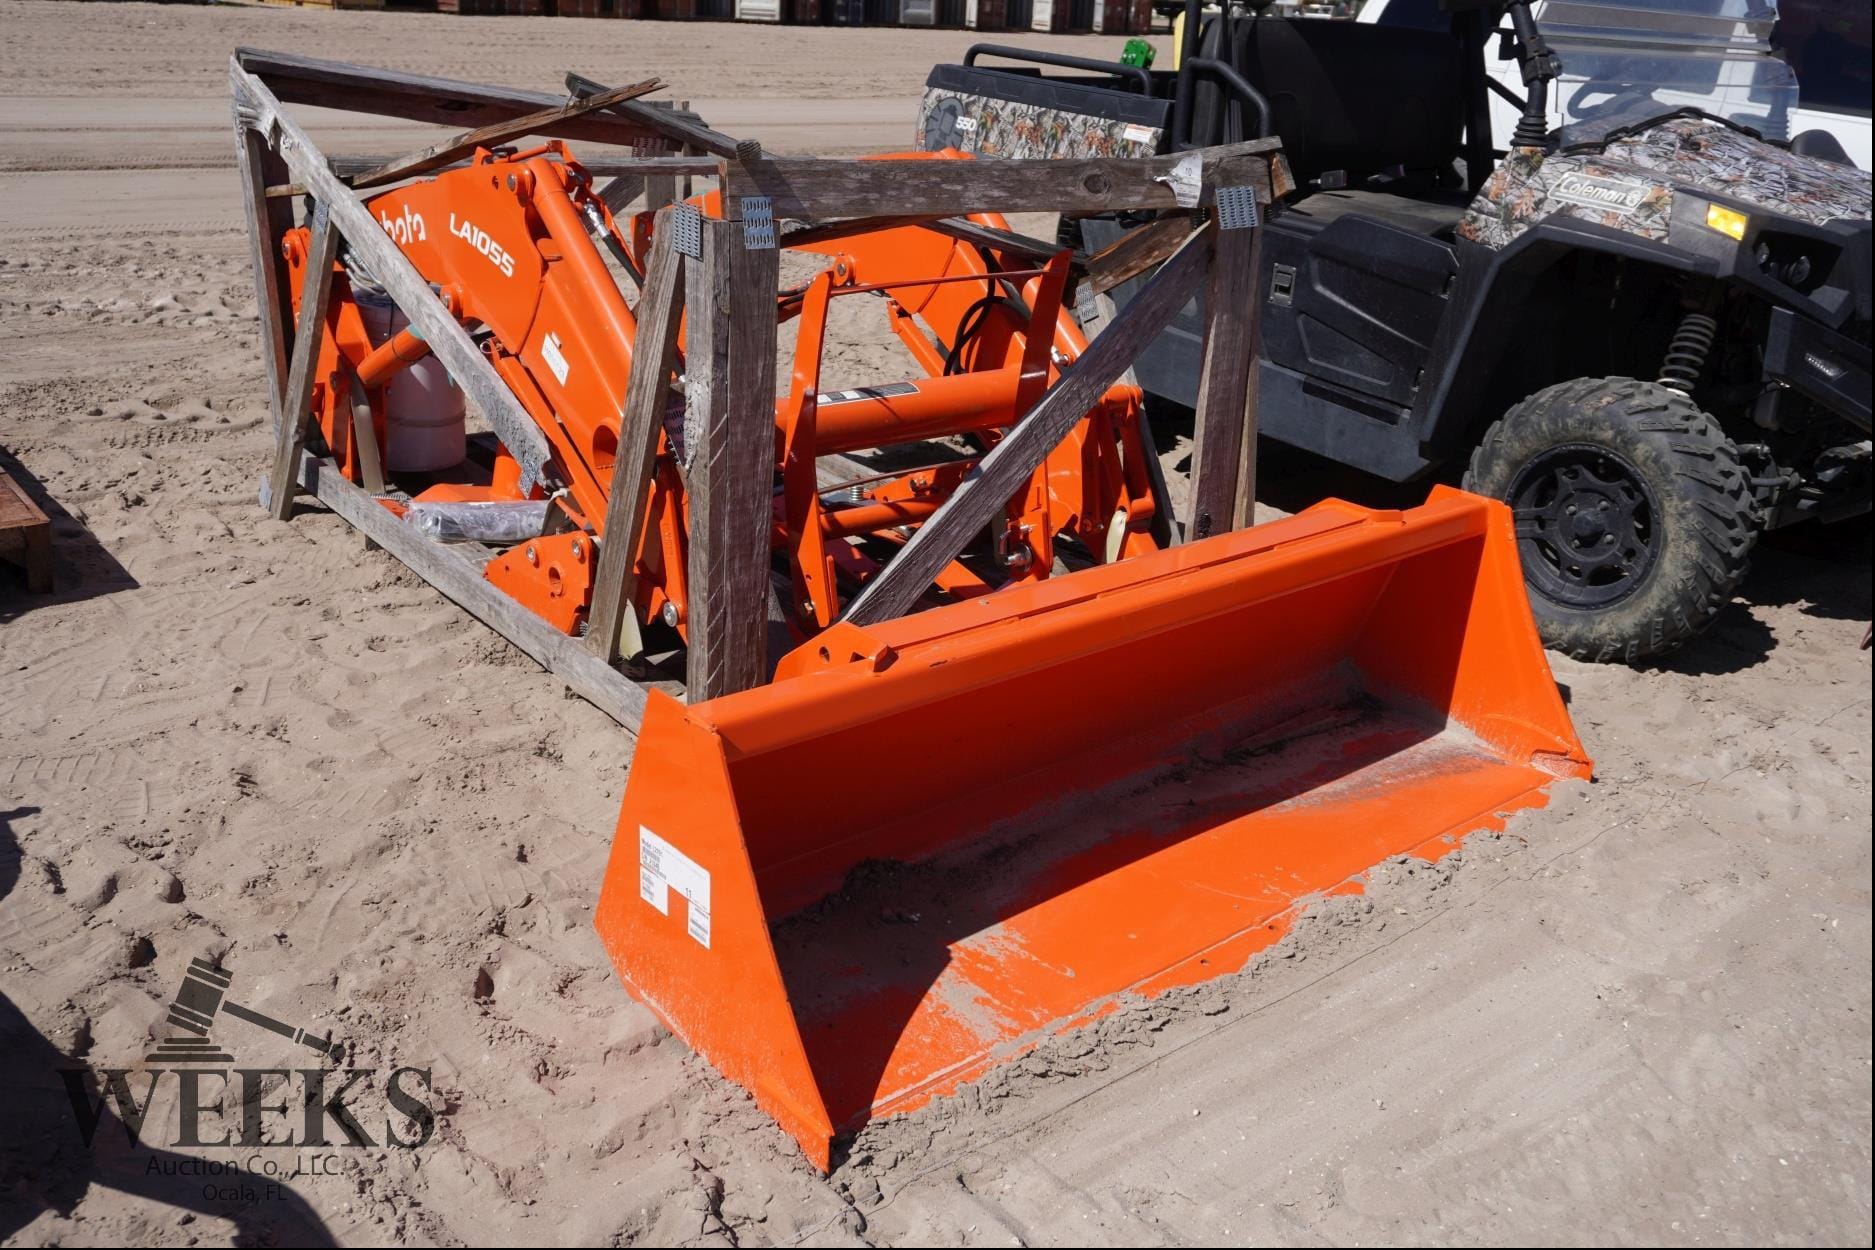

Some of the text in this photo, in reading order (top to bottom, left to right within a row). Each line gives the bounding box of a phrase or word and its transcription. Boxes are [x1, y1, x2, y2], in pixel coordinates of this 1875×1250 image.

[955, 115, 977, 132] 550
[1560, 176, 1626, 204] Coleman
[449, 212, 515, 278] LA1055
